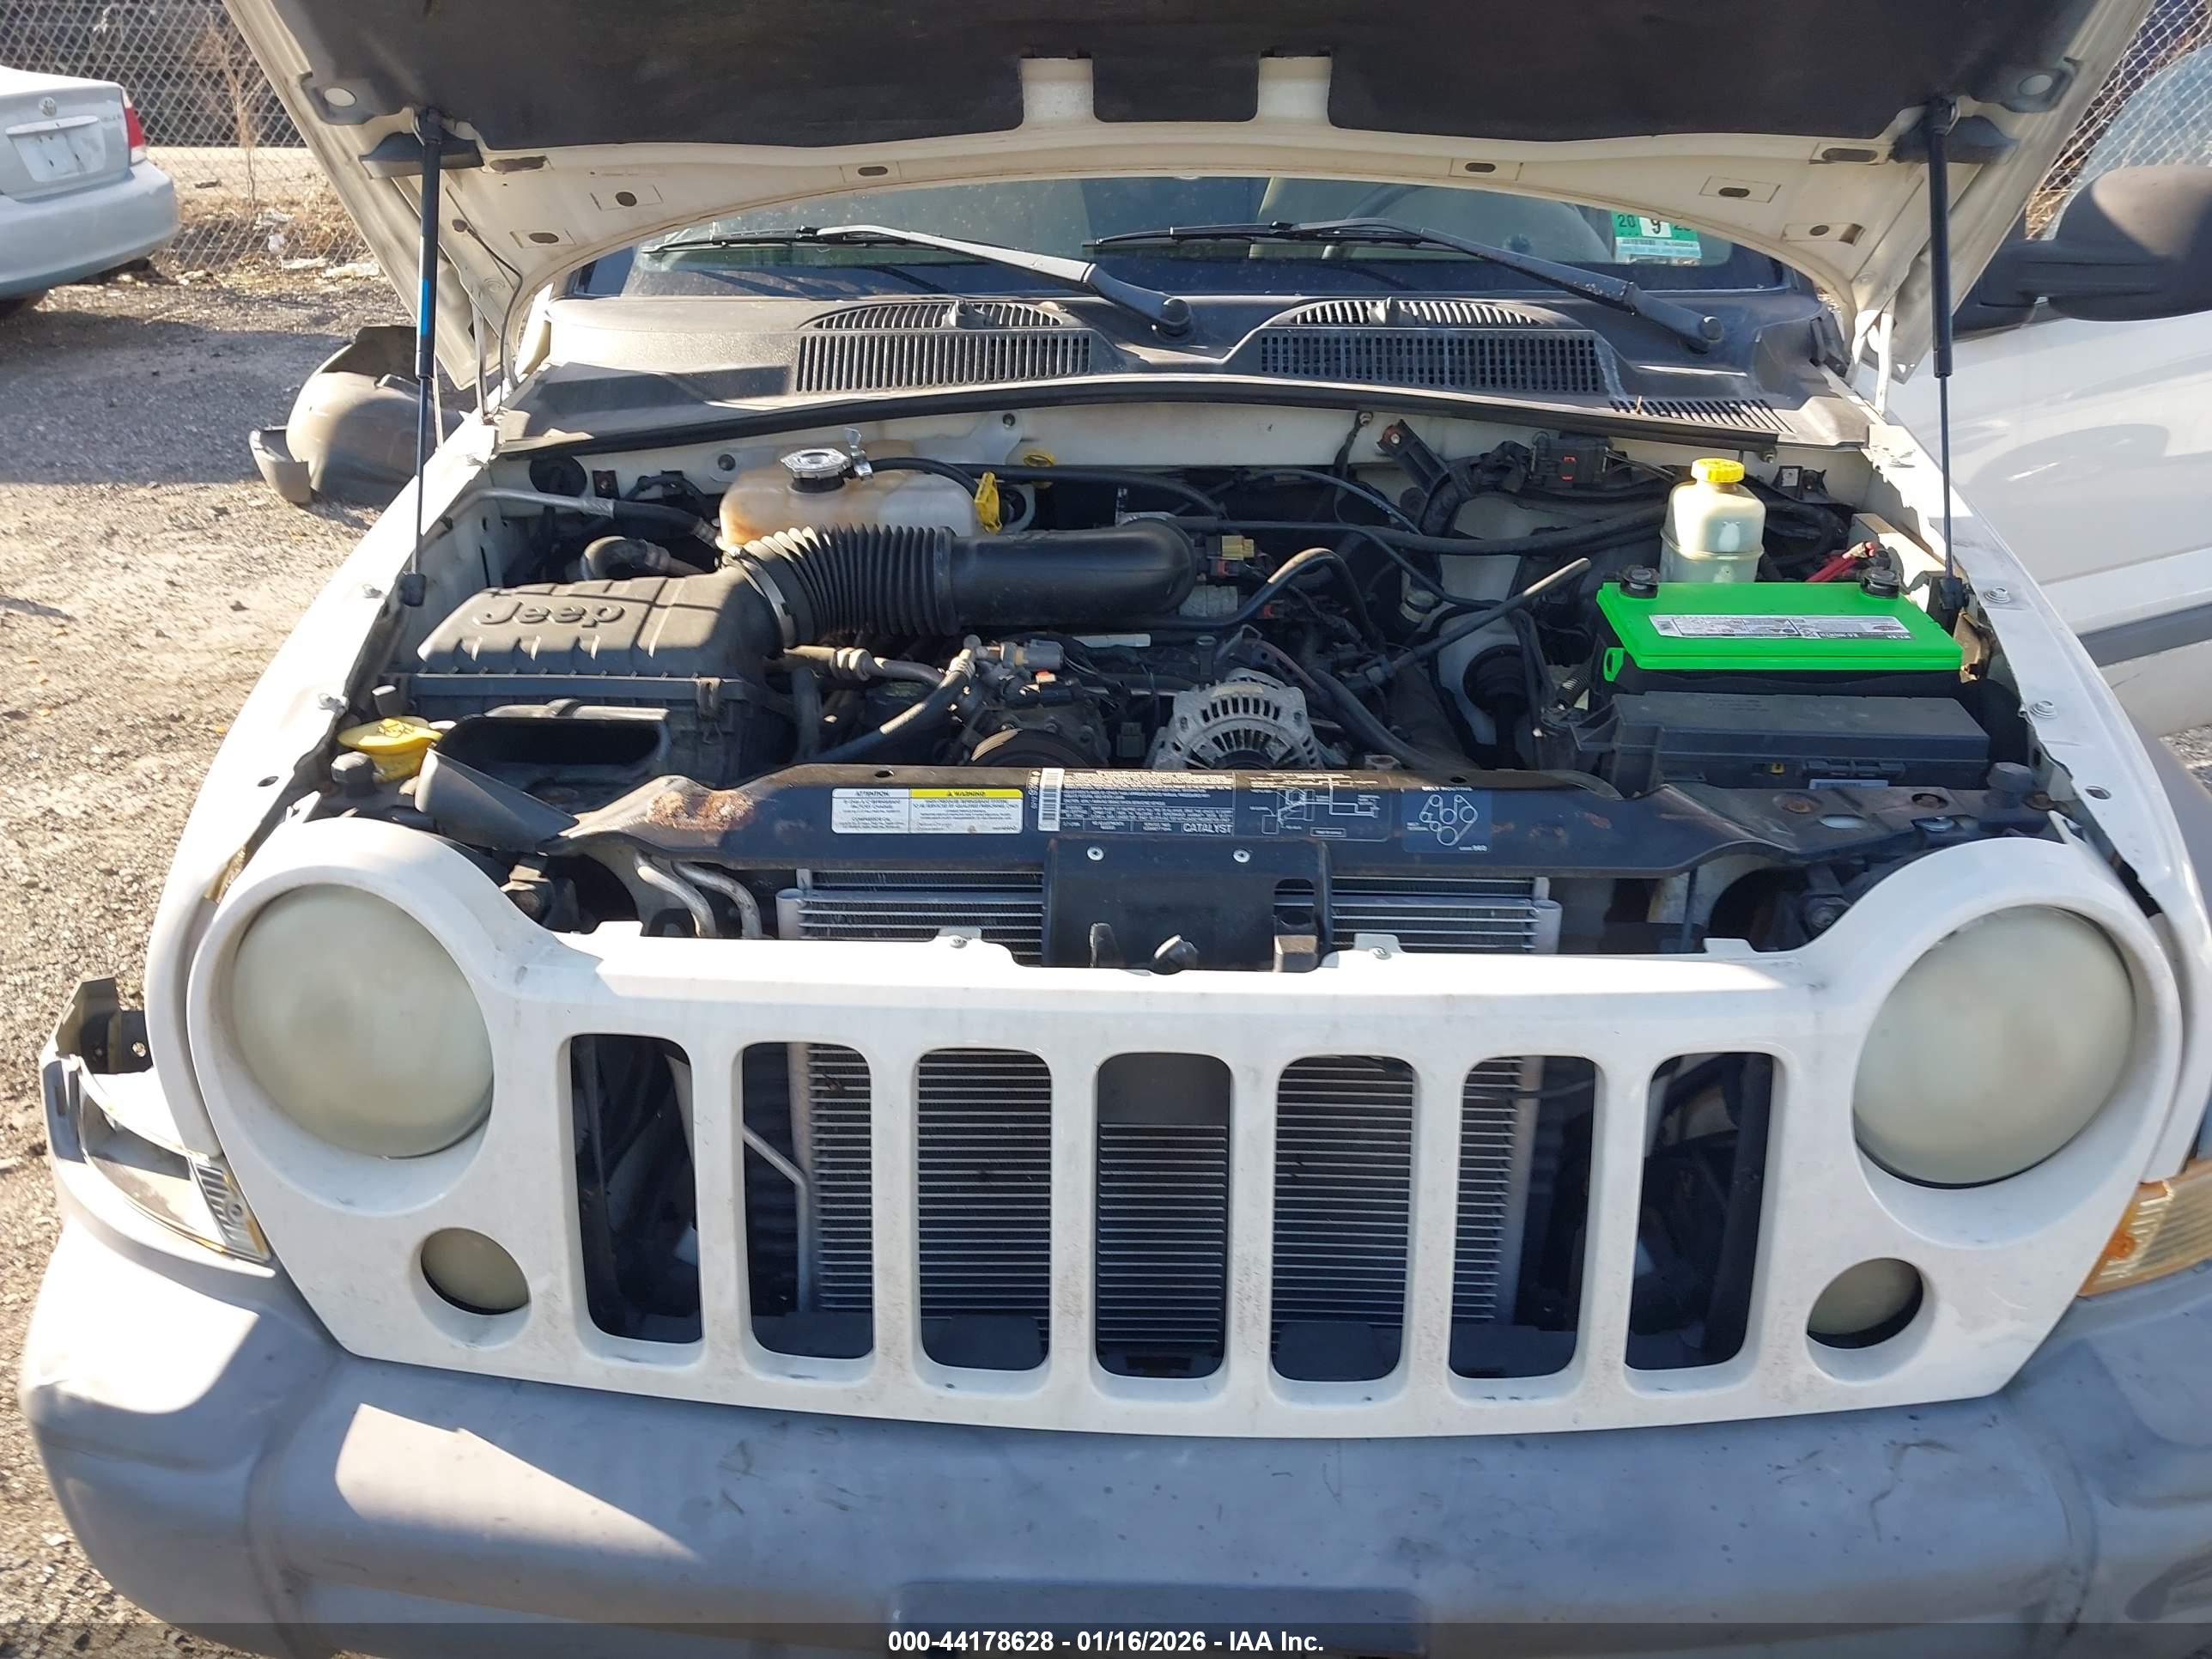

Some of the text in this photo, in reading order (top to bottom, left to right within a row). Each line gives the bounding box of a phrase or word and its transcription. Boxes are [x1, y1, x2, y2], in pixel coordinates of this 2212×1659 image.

[1617, 214, 1636, 228] 20
[472, 601, 626, 629] Jeep
[1182, 823, 1234, 834] CATALYST
